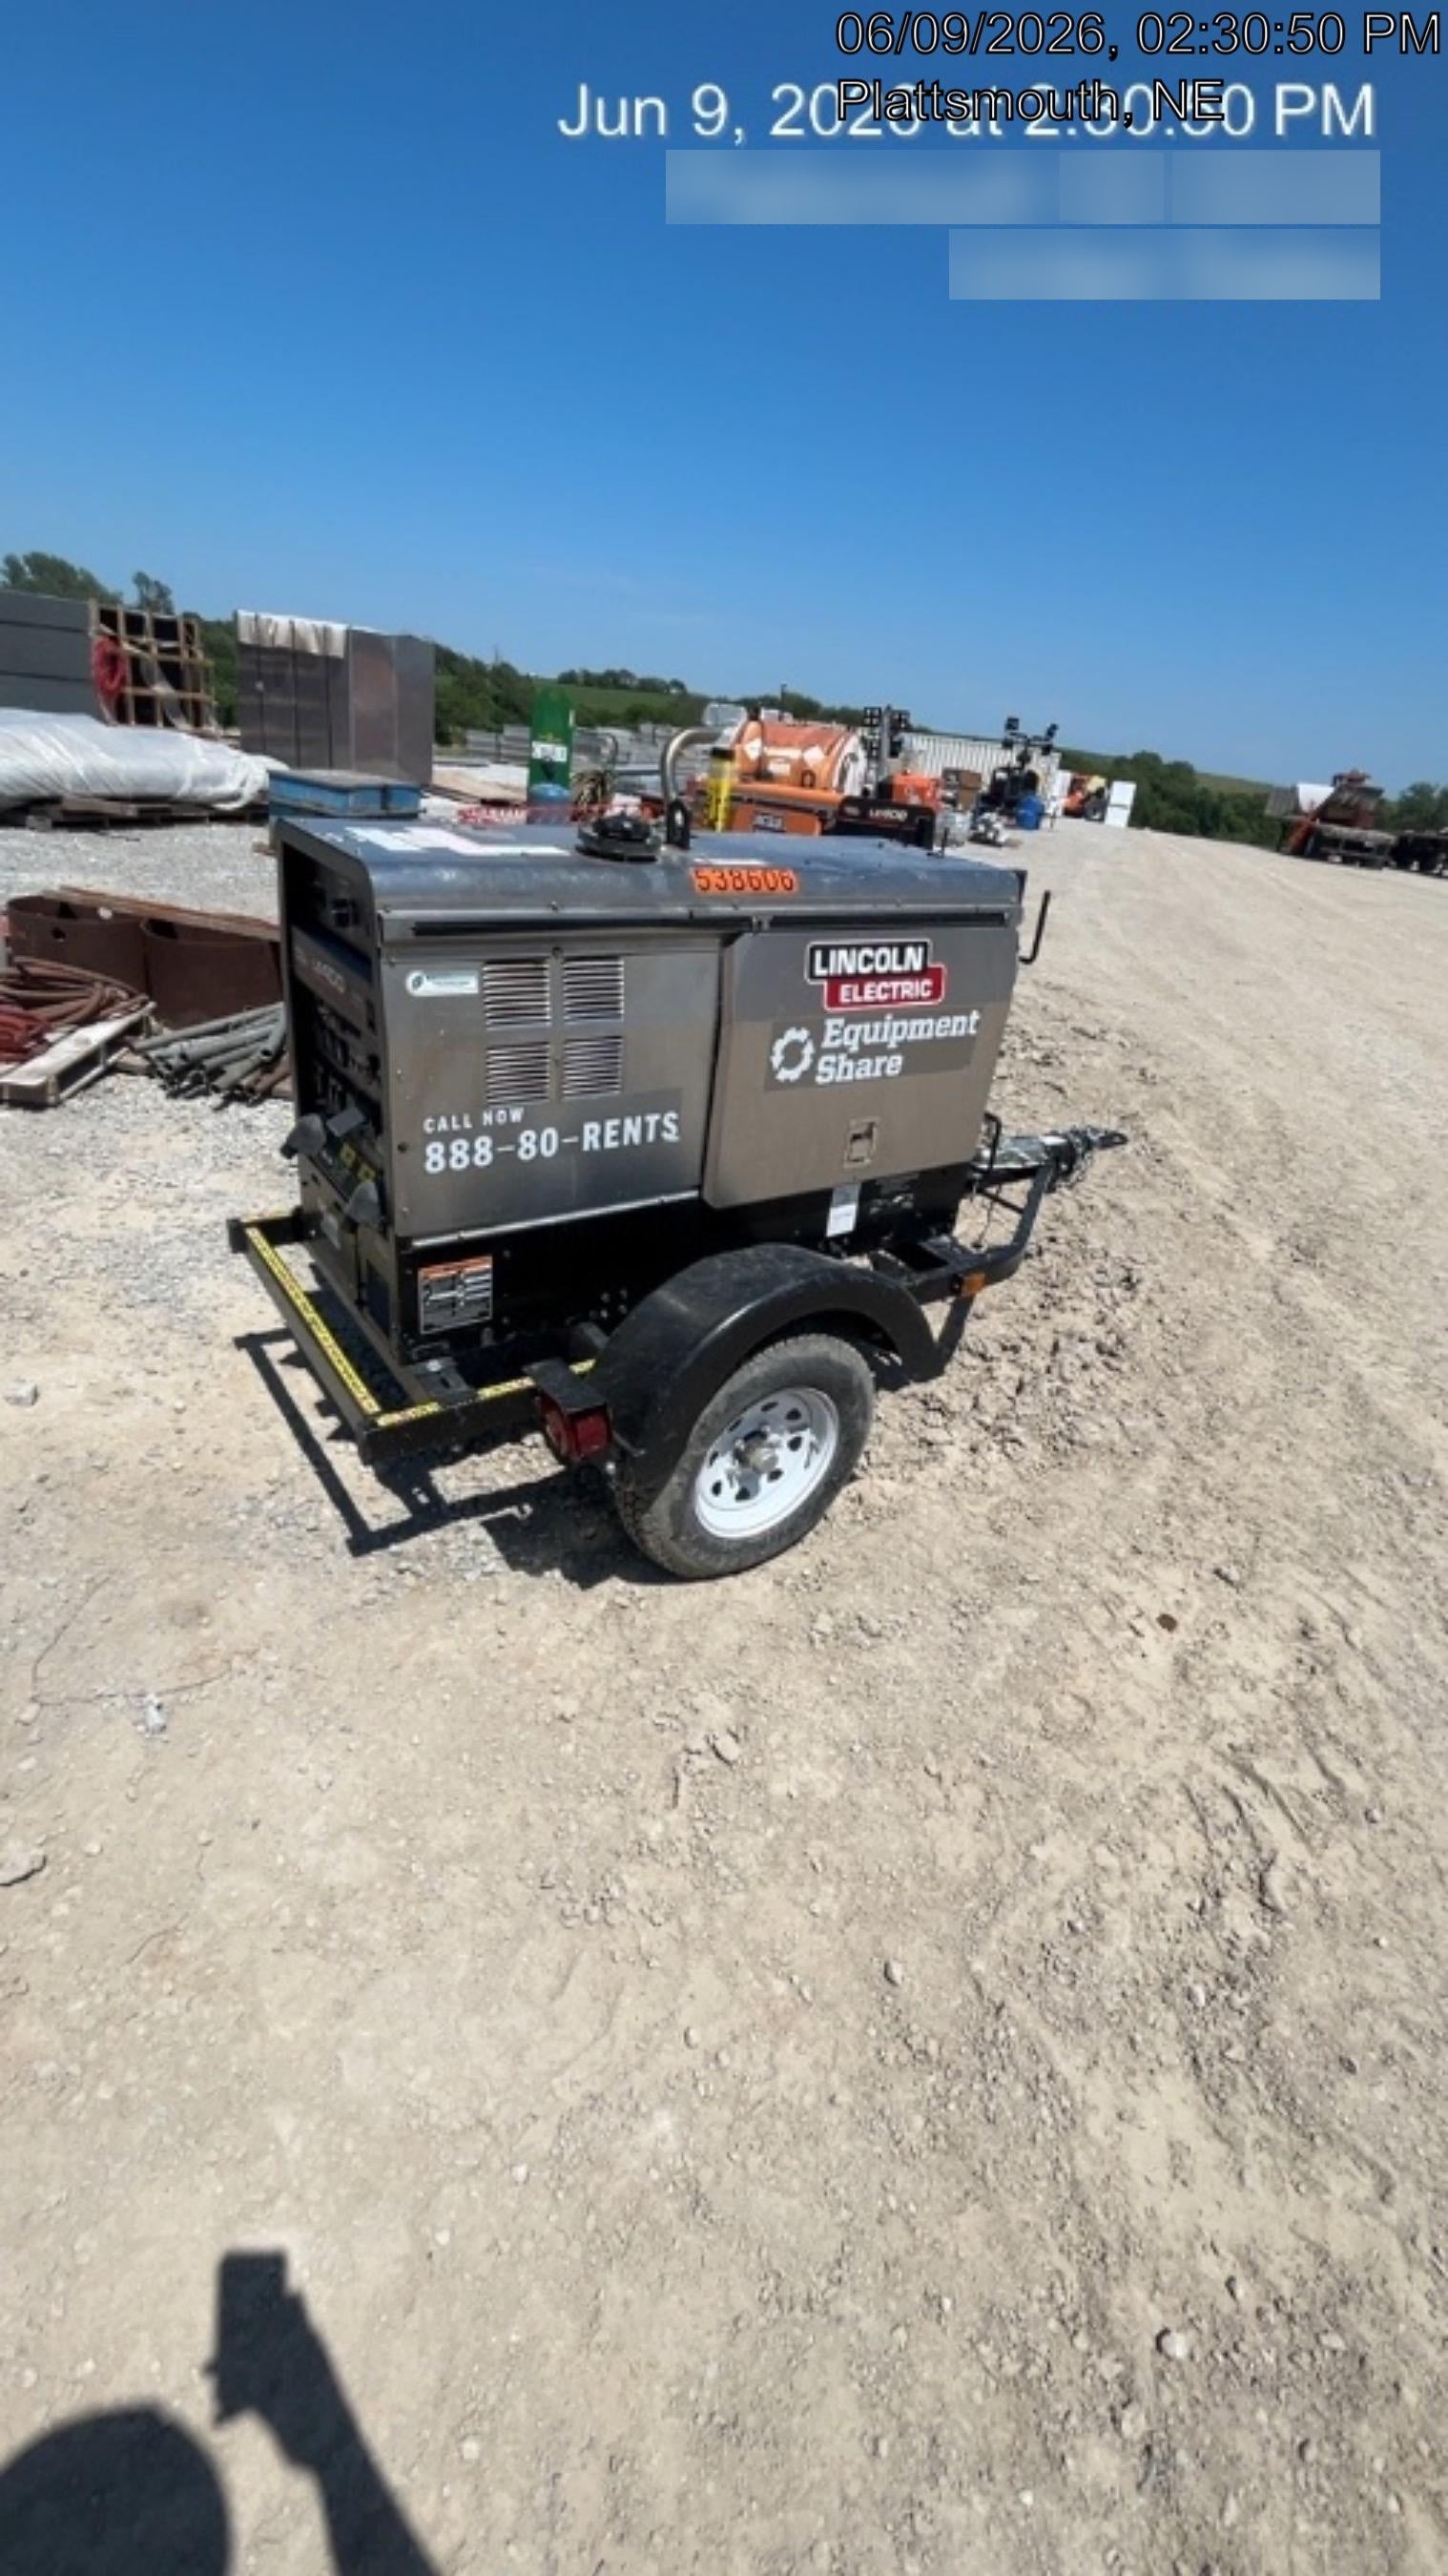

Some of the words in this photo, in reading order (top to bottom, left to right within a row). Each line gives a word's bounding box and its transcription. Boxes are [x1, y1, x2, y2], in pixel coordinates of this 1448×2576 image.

[695, 869, 794, 891] 538606
[814, 946, 924, 976] LINCOLN
[839, 980, 933, 1004] ELECTRIC
[820, 1009, 981, 1052] Equipment
[815, 1053, 903, 1084] Share
[423, 1112, 473, 1133] CALL
[483, 1107, 525, 1126] NOW
[424, 1111, 679, 1174] 888-80-RENTS
